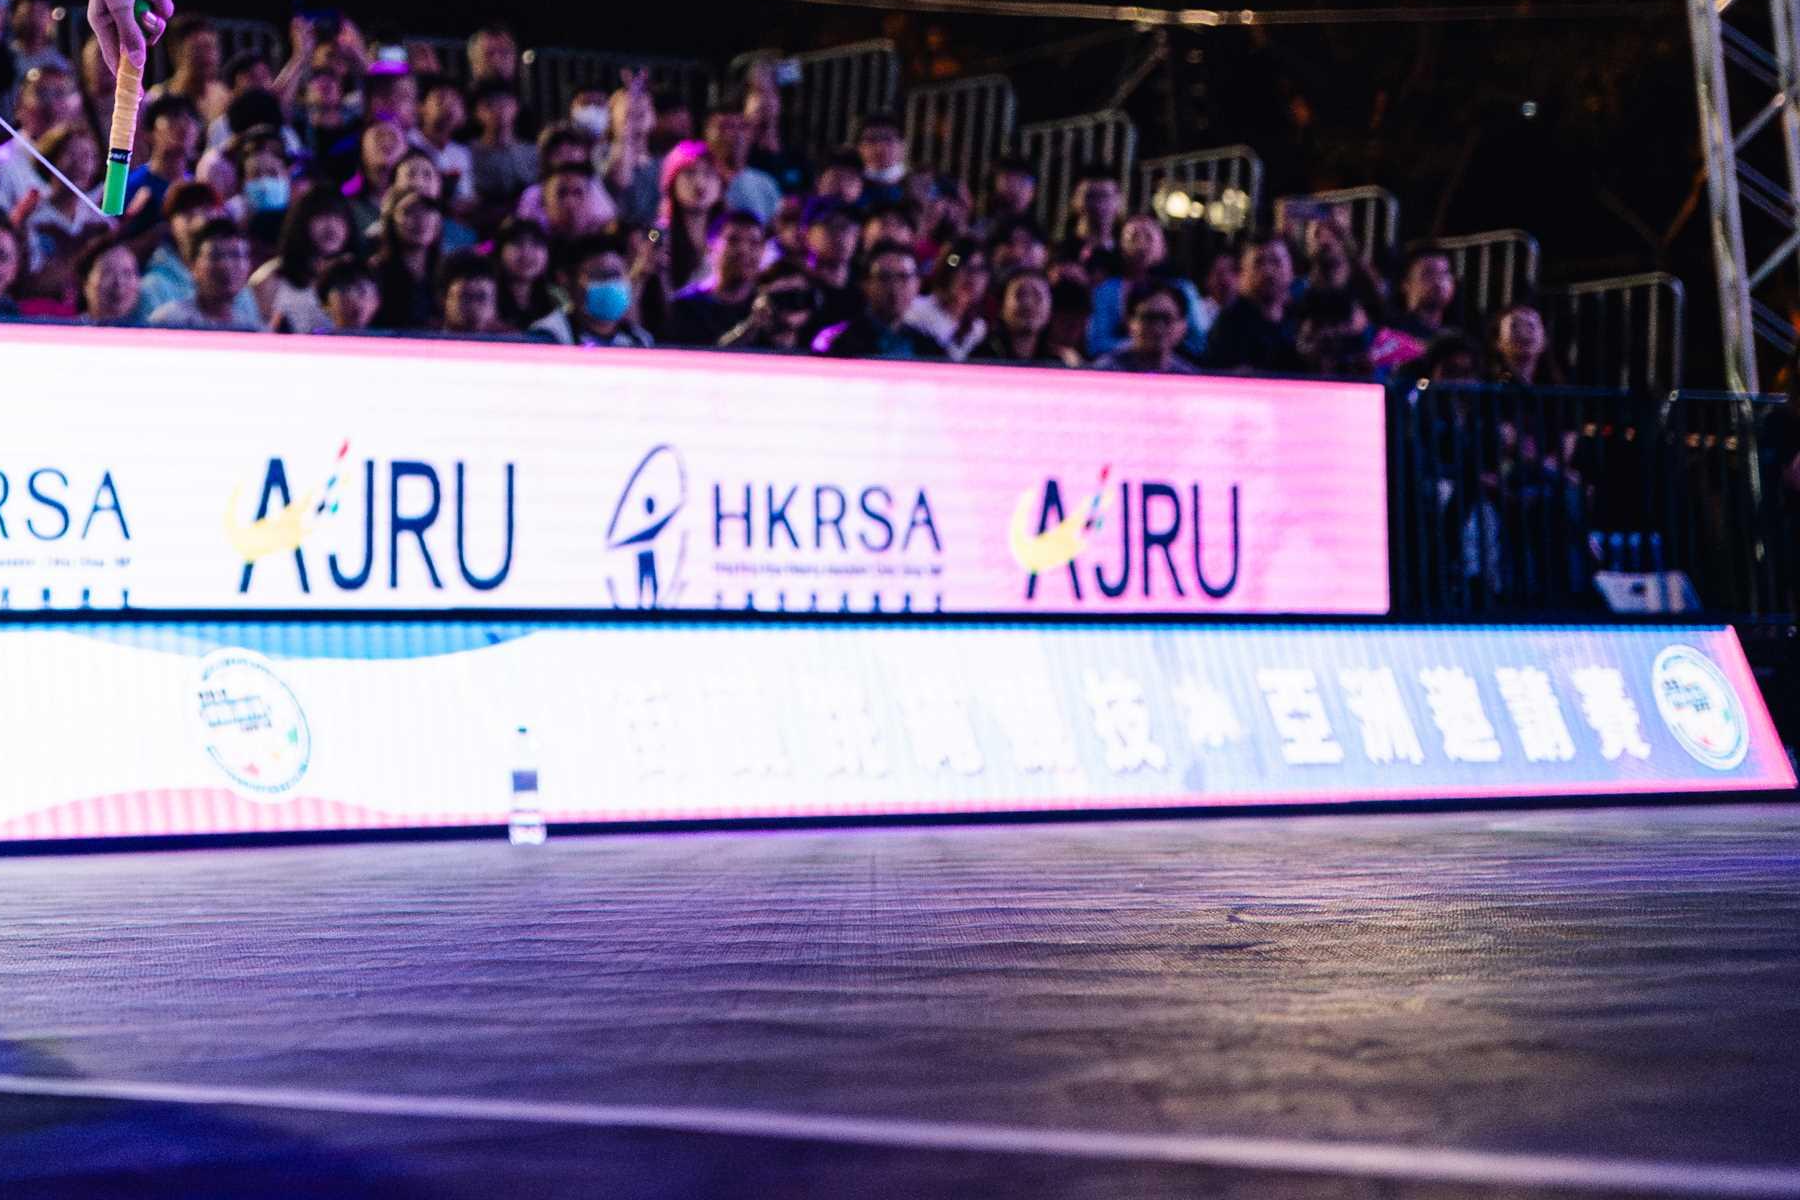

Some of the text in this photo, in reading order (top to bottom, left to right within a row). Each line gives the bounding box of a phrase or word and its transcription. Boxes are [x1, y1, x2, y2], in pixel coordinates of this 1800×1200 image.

[239, 457, 515, 593] AJRU
[713, 483, 943, 553] HKRSA
[1026, 479, 1241, 600] AJRU
